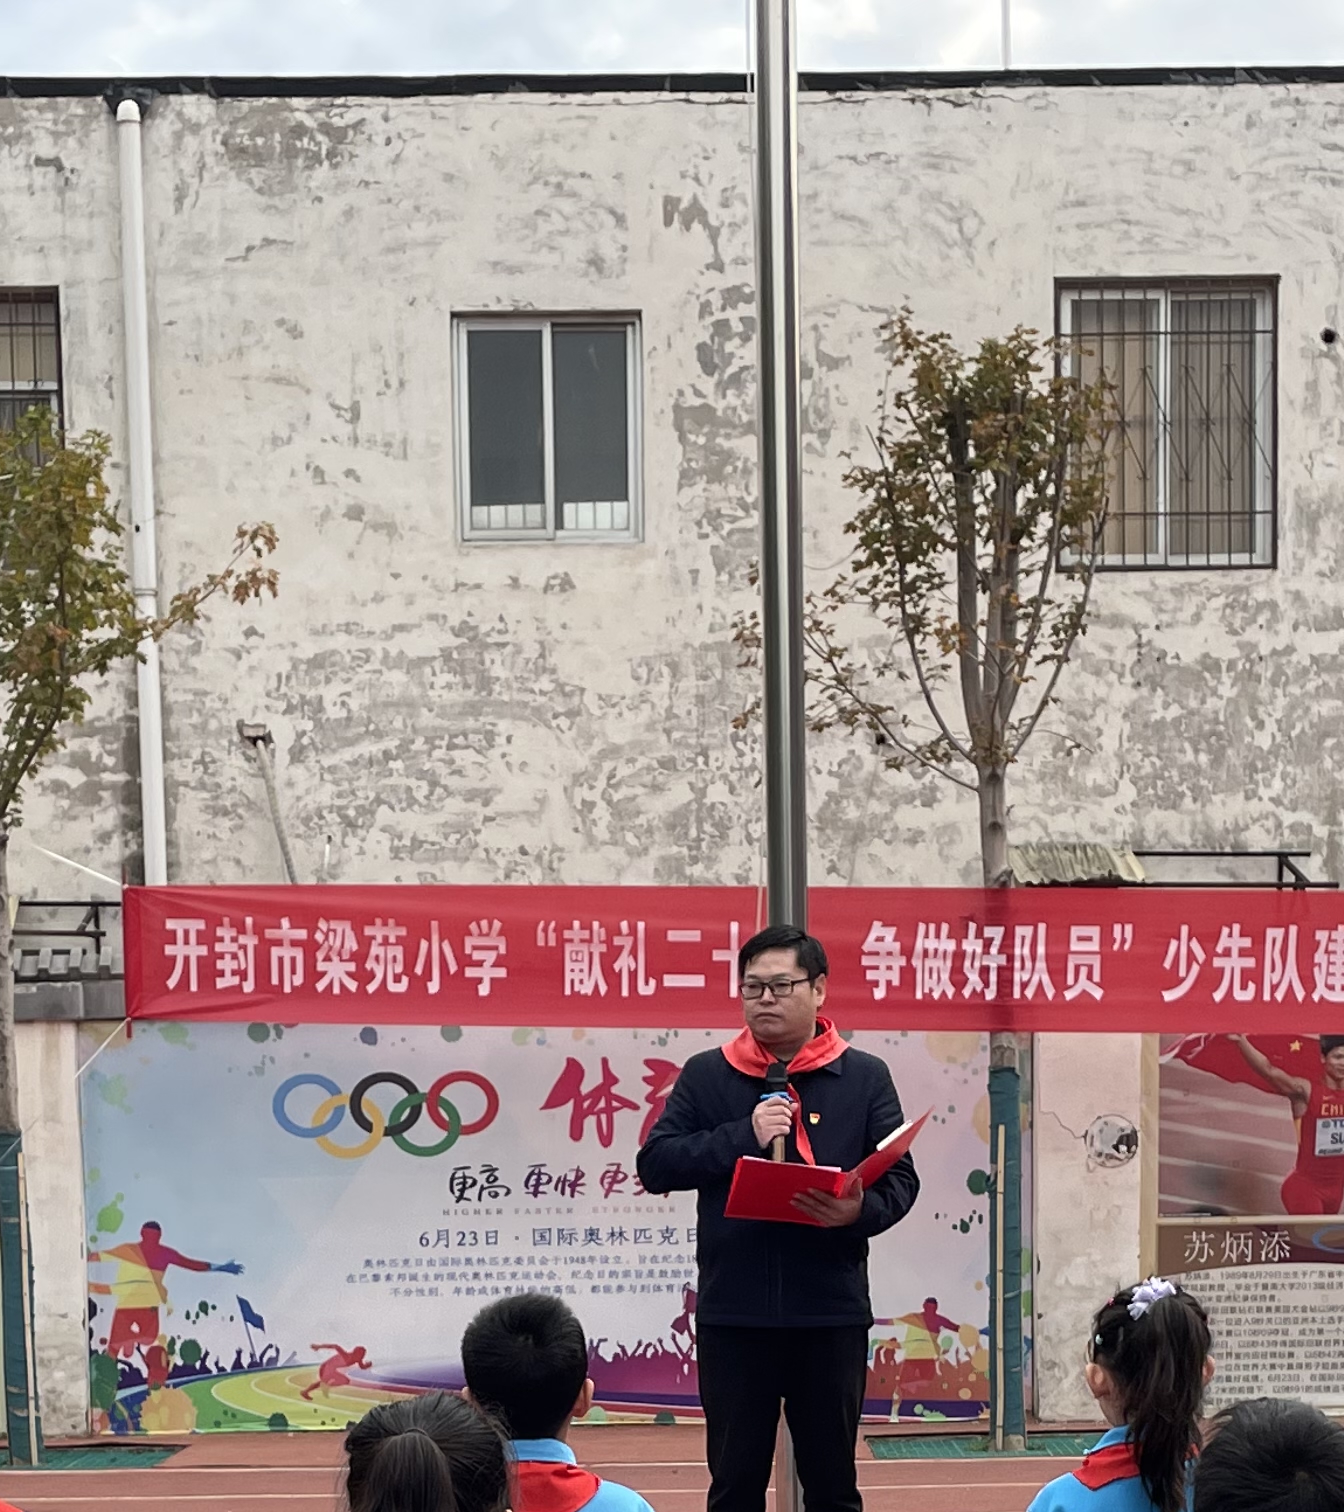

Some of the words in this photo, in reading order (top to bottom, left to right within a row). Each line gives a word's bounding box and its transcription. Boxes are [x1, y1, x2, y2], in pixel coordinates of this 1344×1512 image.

[448, 1164, 512, 1204] 更高
[523, 1162, 587, 1200] 更快
[443, 1208, 504, 1217] HIGHER
[514, 1206, 574, 1216] FASTER
[1183, 1230, 1291, 1264] 苏炳添
